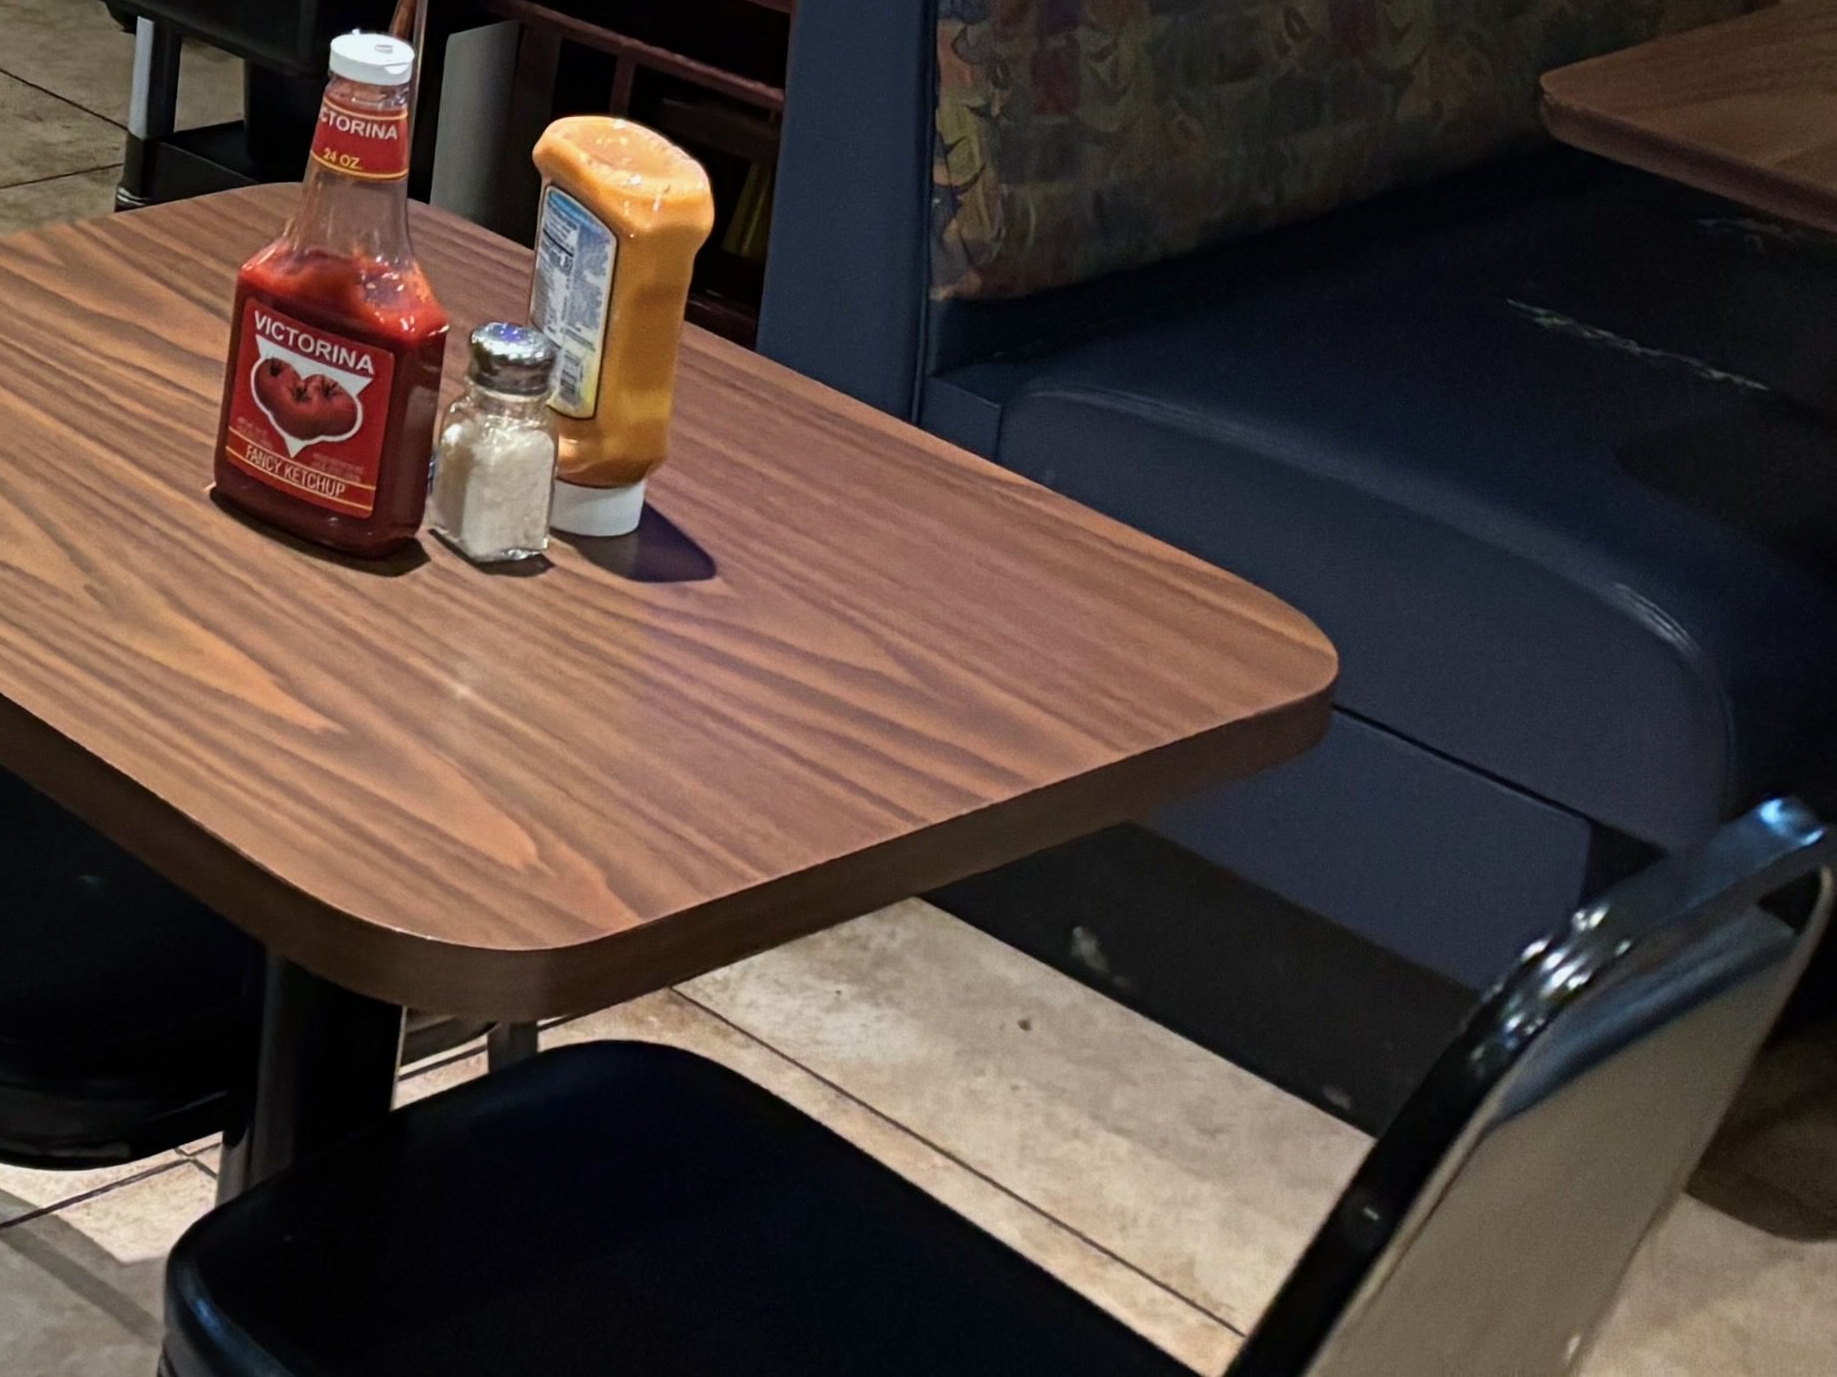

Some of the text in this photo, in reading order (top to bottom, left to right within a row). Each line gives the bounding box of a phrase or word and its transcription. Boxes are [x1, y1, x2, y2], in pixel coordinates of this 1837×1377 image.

[323, 147, 338, 163] 24
[254, 310, 375, 377] VICTORINA
[246, 445, 284, 473] FANCY
[283, 463, 347, 498] KETCHUP
